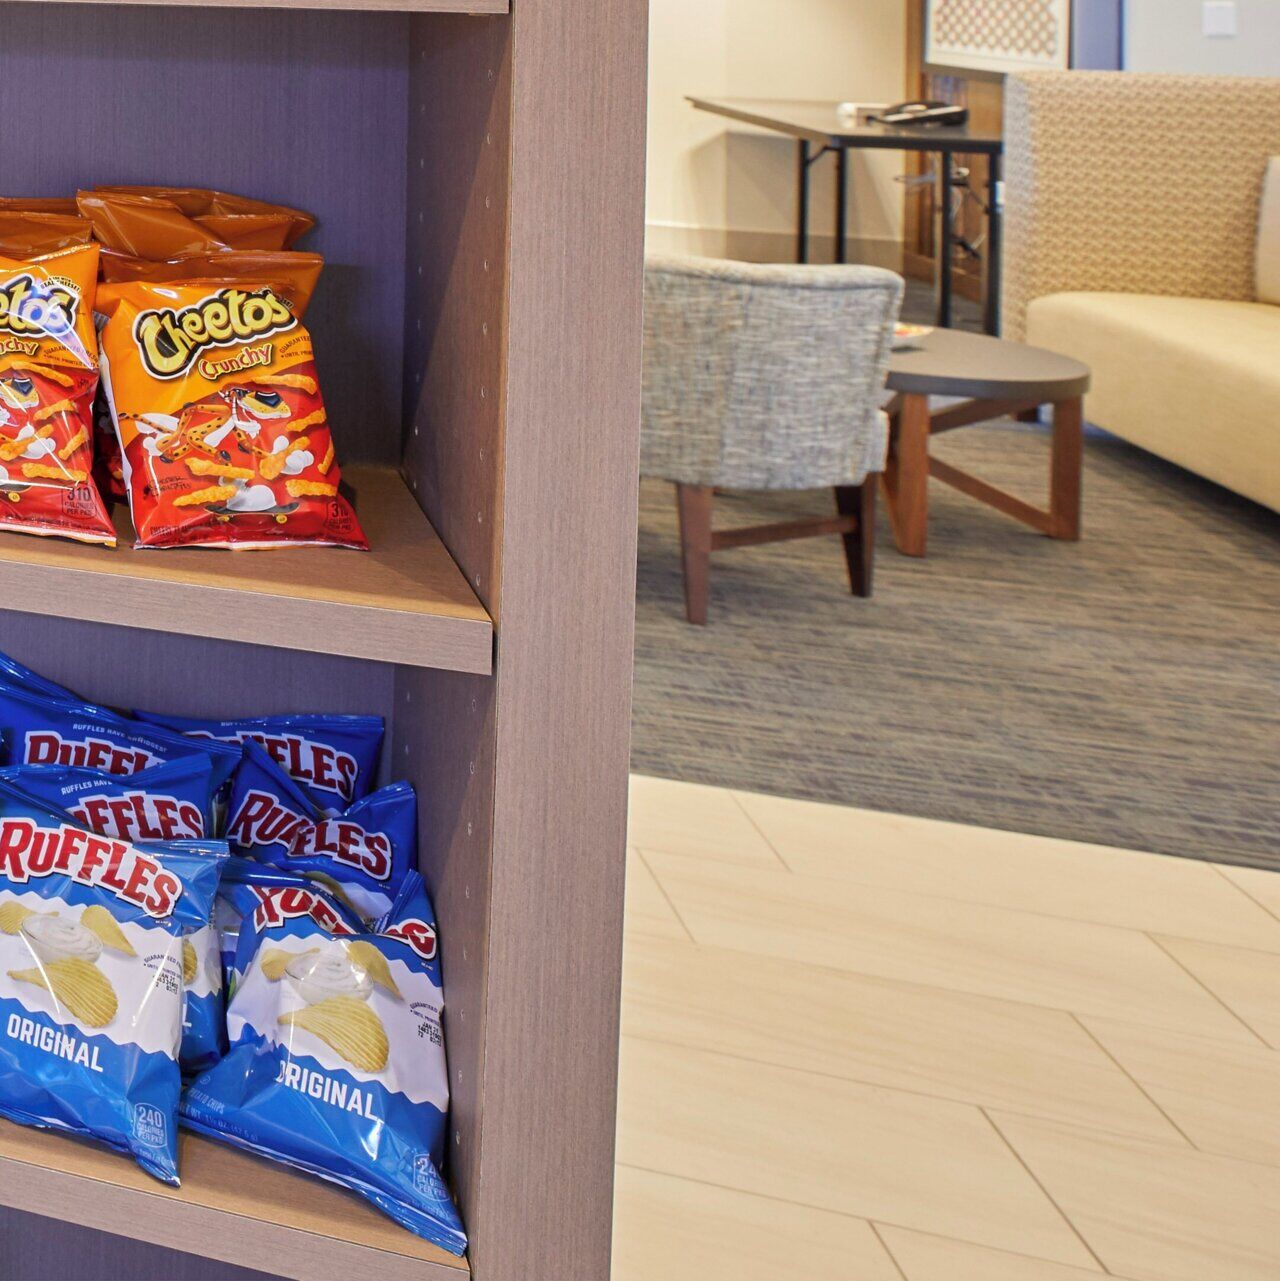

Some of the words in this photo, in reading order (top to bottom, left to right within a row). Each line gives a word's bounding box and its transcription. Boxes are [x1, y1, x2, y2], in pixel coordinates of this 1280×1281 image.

[135, 289, 296, 377] Cheetos
[199, 344, 272, 379] Crunchy
[67, 488, 91, 501] 310
[73, 724, 105, 733] RUFFLES
[61, 783, 92, 795] RUFFLES
[7, 1013, 104, 1073] ORIGINAL
[275, 1060, 378, 1119] ORIGINAL
[139, 1107, 162, 1127] 240
